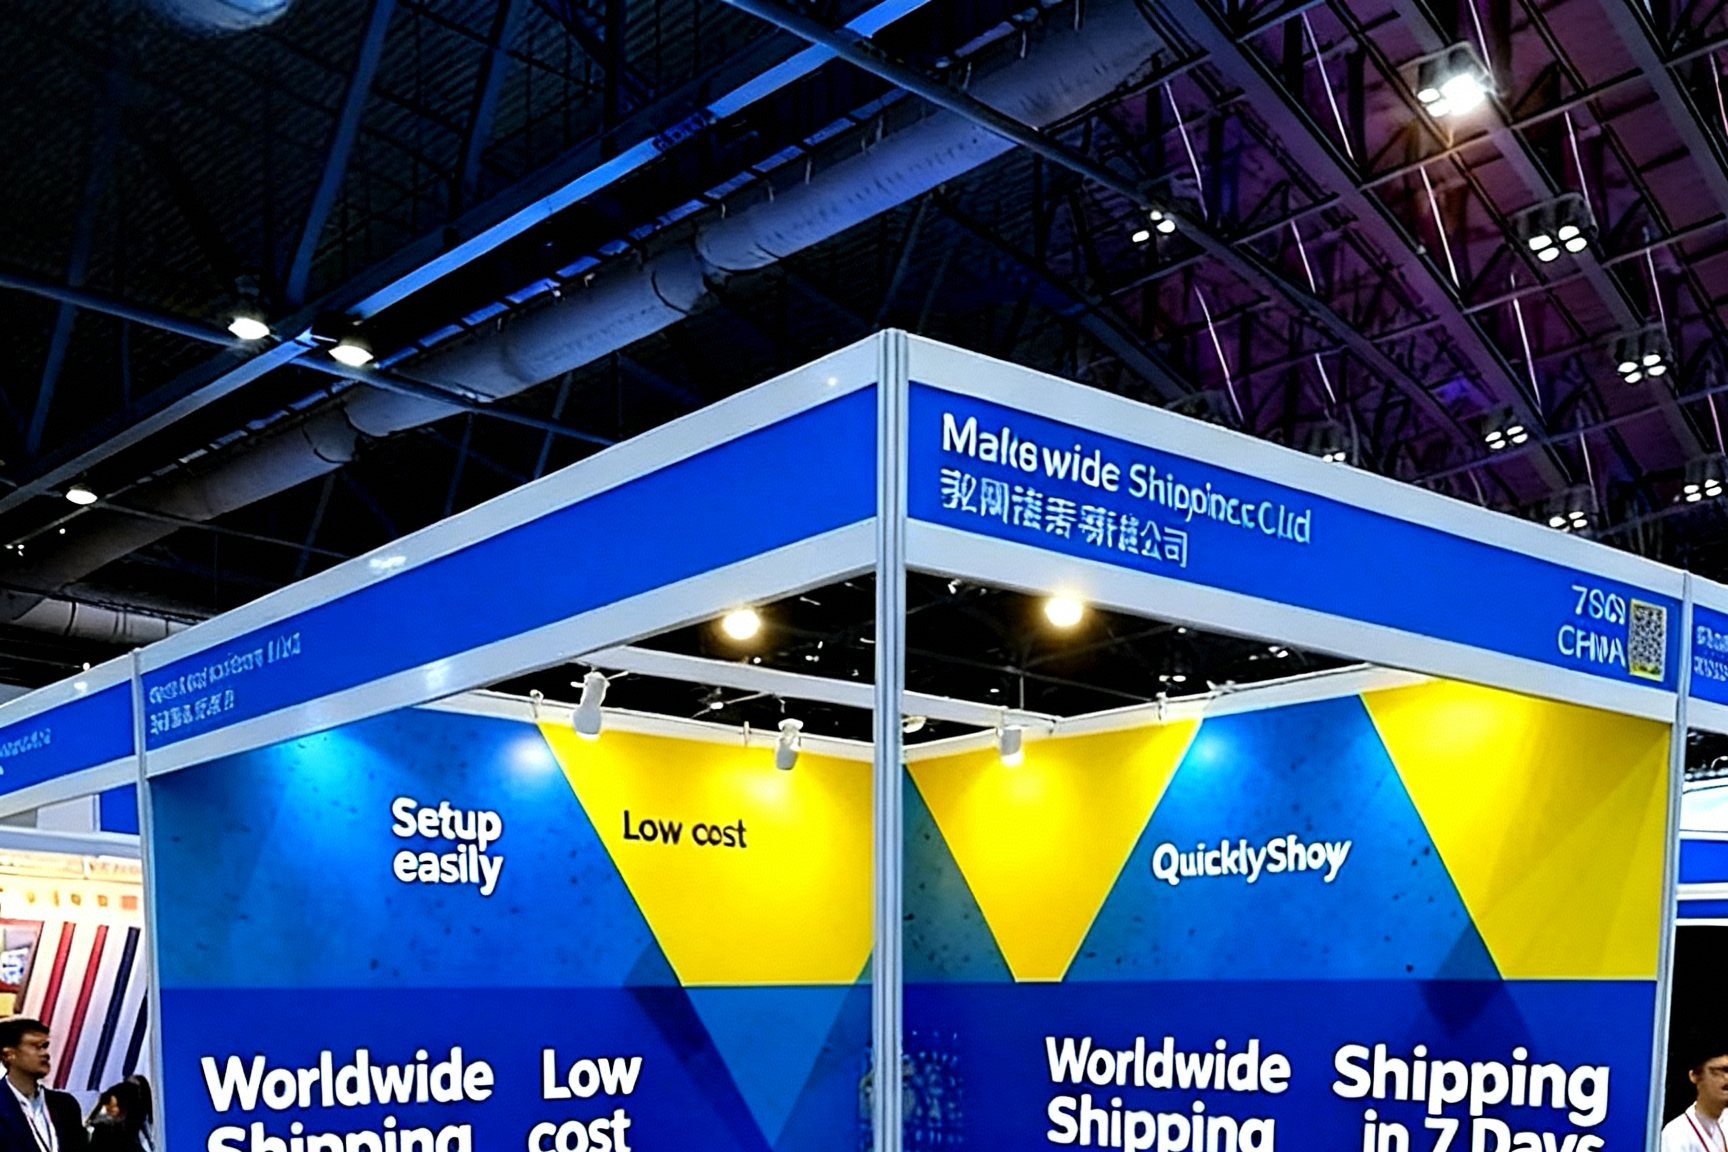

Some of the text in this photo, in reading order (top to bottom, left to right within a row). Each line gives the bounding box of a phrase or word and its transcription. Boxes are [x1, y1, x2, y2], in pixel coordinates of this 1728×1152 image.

[391, 797, 502, 851] Setup
[623, 810, 747, 848] Low cost
[392, 844, 503, 896] easily
[201, 1046, 495, 1113] Worldwide
[542, 1048, 643, 1100] Low
[1045, 1036, 1291, 1093] Worldwide
[1332, 1043, 1610, 1127] Shipping
